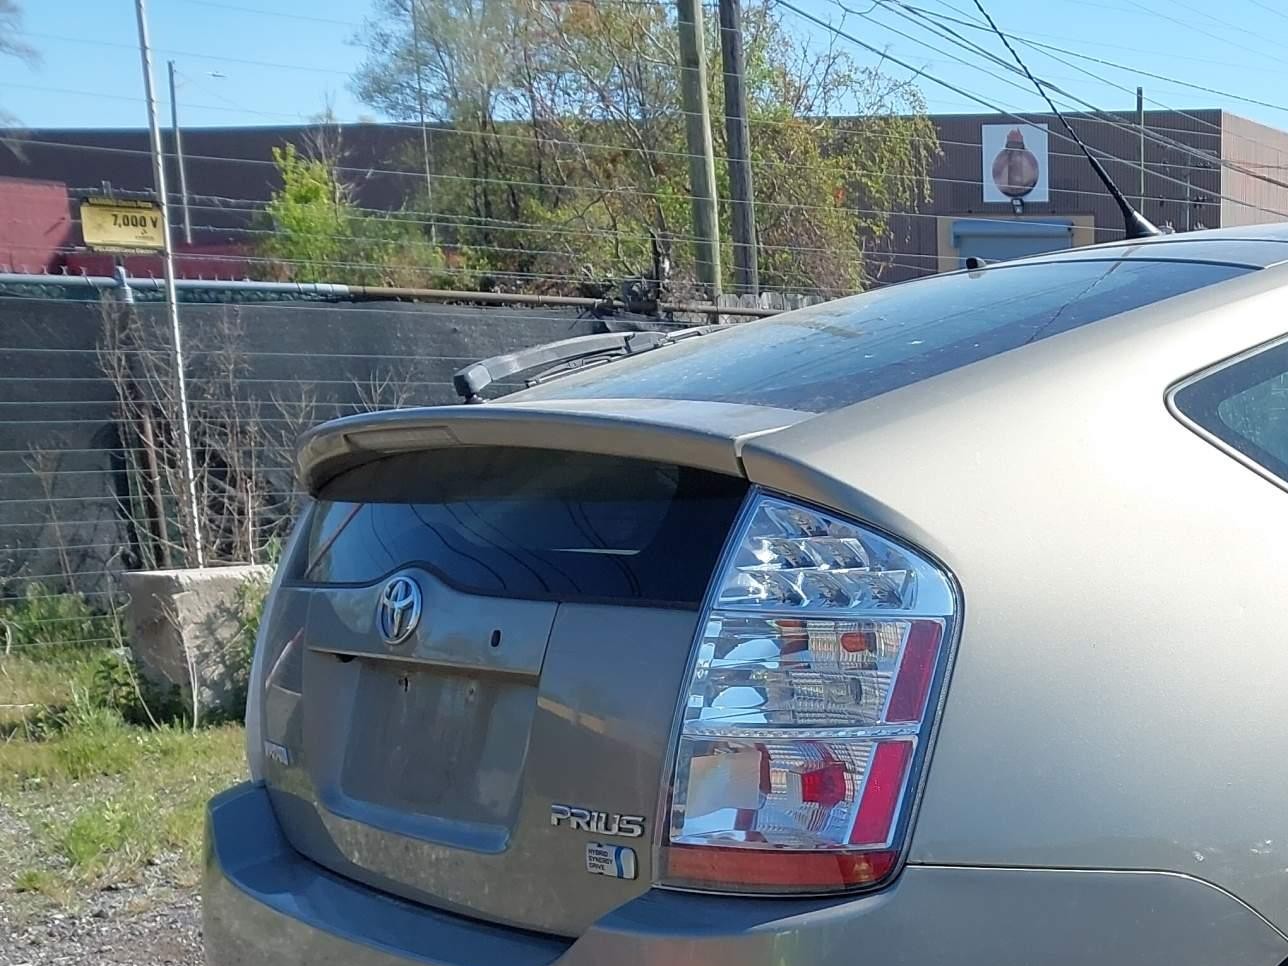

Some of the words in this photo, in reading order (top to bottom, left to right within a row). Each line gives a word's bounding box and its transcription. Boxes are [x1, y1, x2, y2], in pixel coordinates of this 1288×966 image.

[111, 213, 147, 228] 7,000
[150, 215, 158, 229] V
[551, 803, 645, 837] PRIUS
[588, 848, 609, 857] HYBRID
[588, 855, 613, 865] SYNERGY
